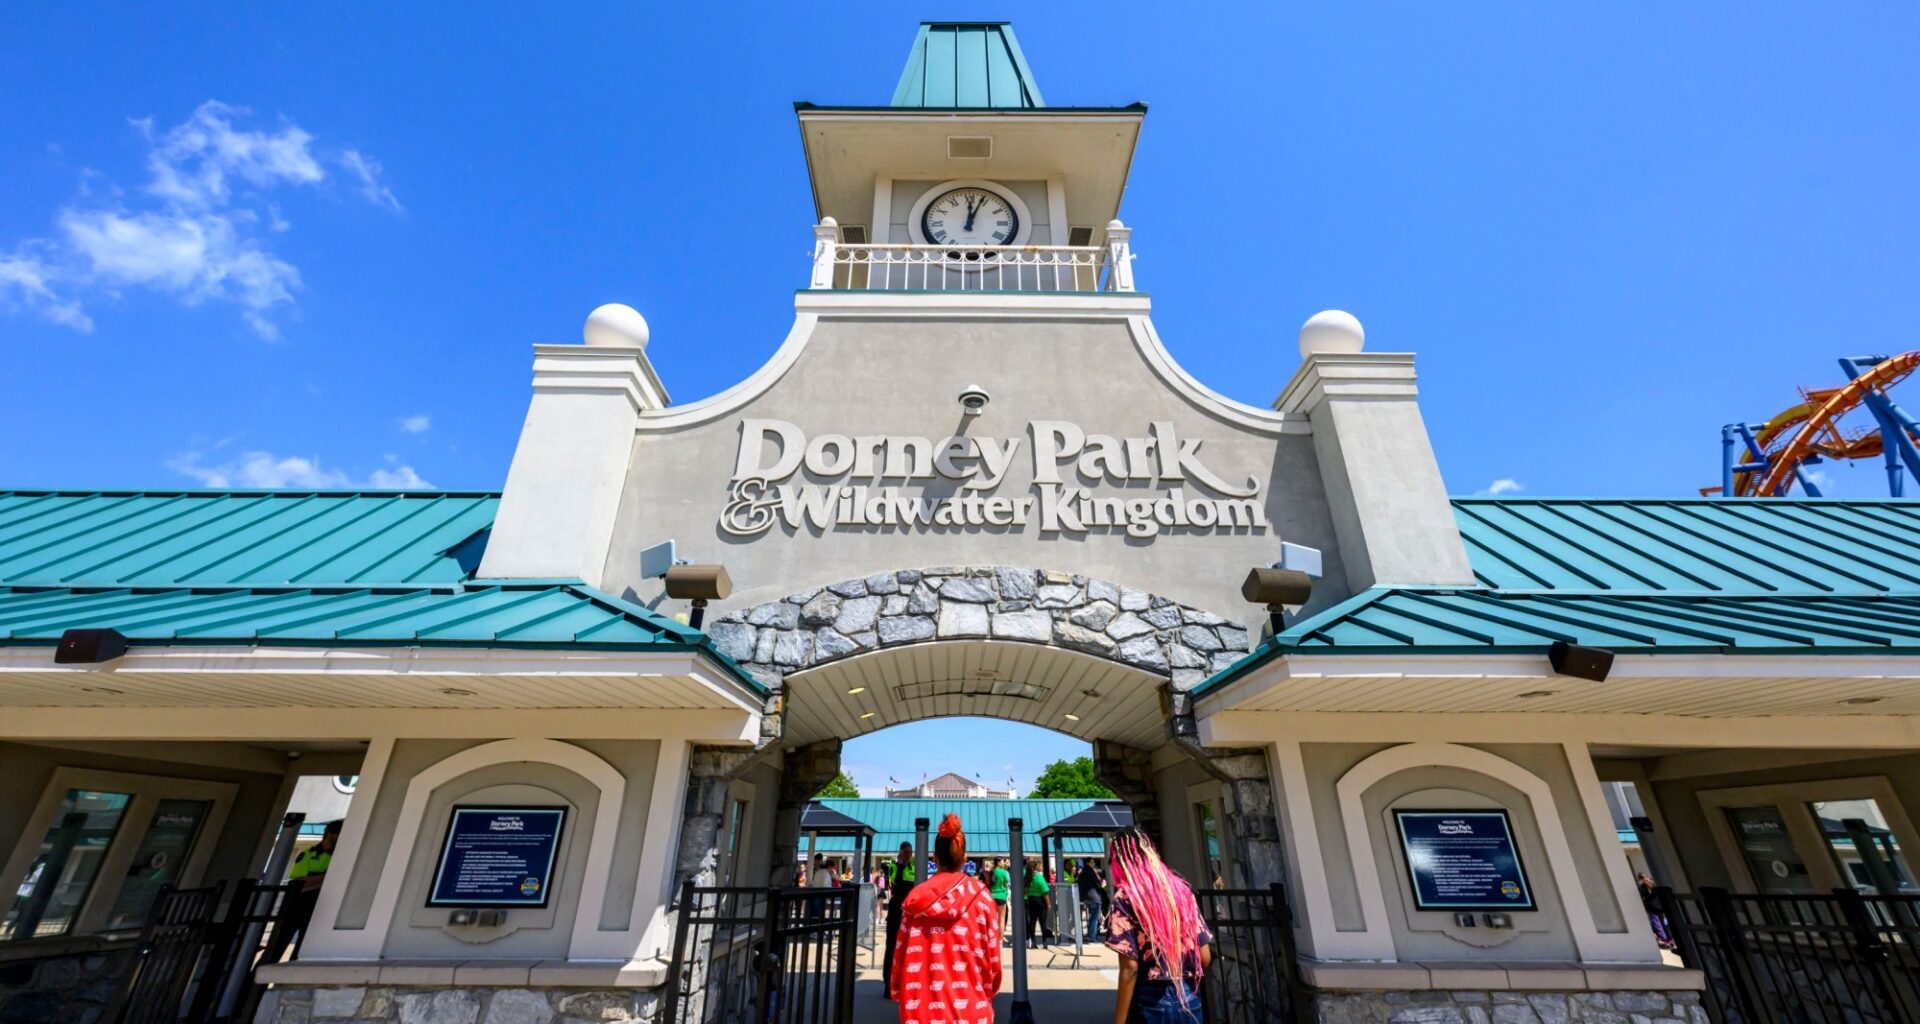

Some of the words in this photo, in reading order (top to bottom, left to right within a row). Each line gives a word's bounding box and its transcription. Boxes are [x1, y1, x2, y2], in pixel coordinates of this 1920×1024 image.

[731, 418, 1021, 491] Dorney
[1029, 420, 1261, 498] Park
[720, 476, 783, 536] &
[776, 484, 1034, 529] Wildwater
[1038, 483, 1268, 538] Kingdom
